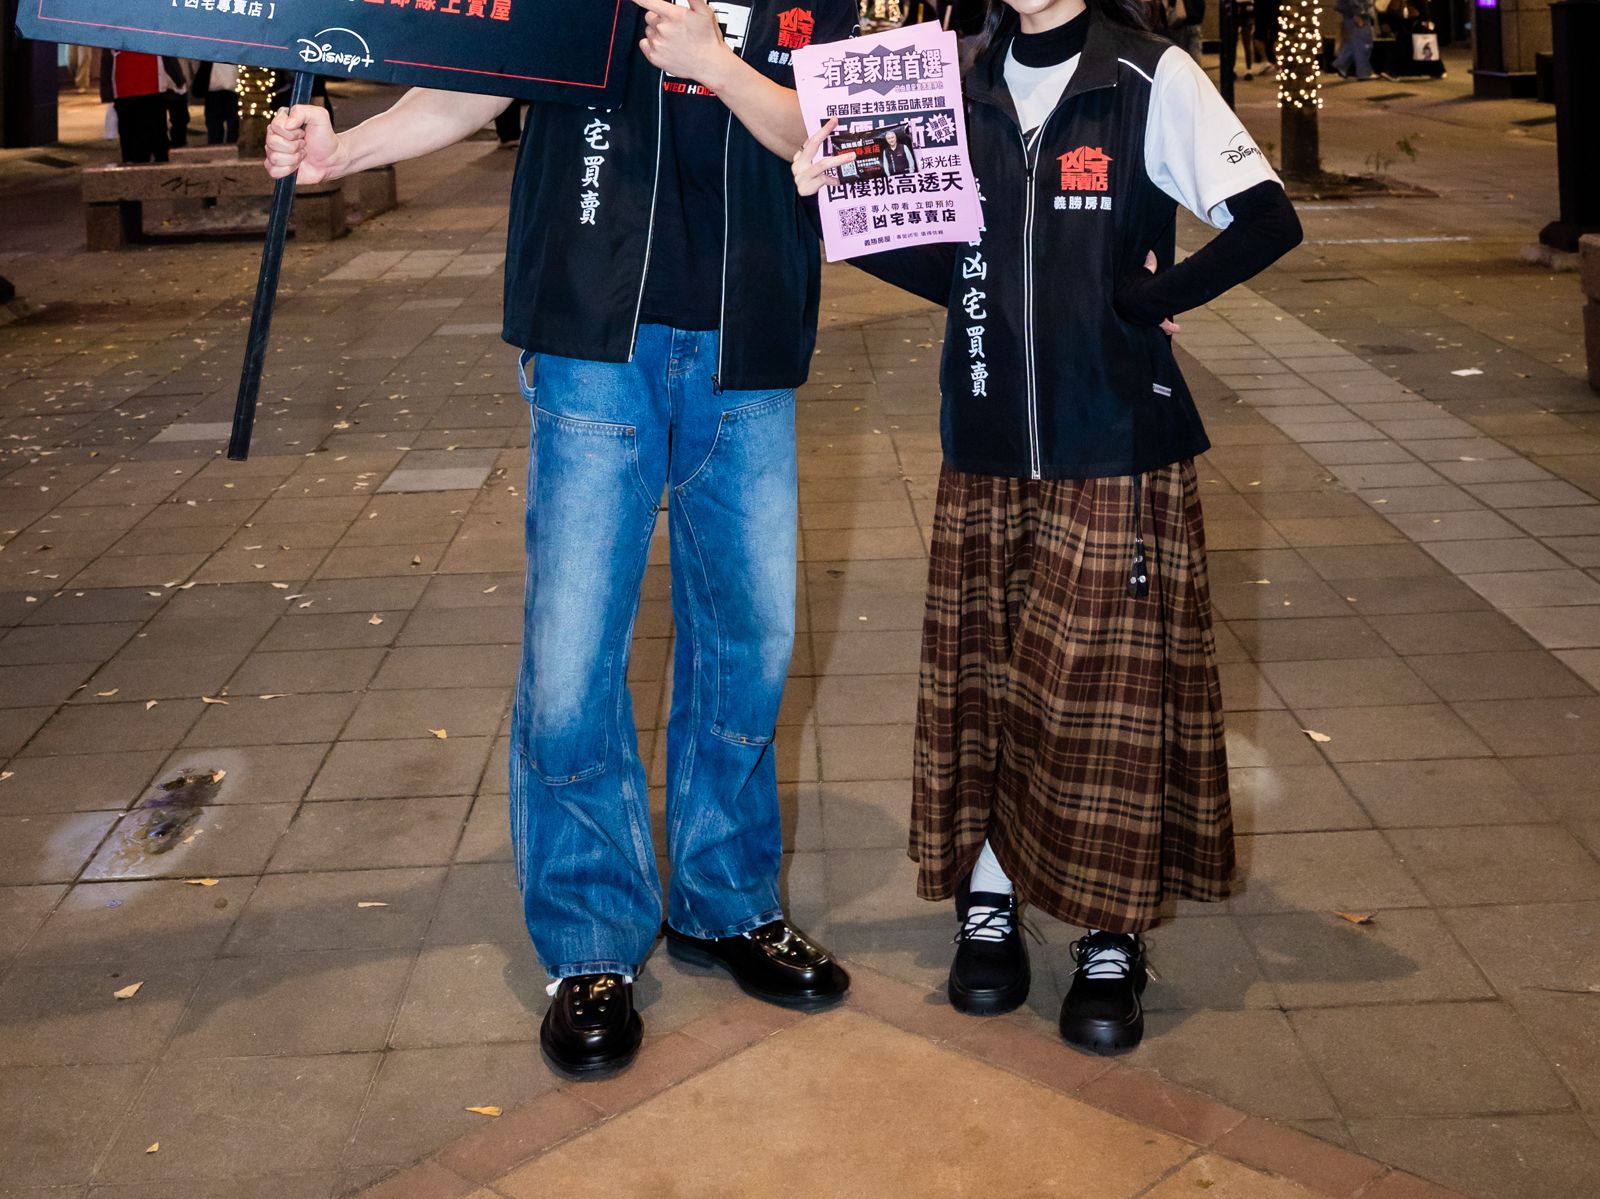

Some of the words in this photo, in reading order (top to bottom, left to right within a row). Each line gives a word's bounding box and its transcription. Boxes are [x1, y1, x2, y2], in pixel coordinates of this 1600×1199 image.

[822, 48, 943, 88] 有愛家庭首選
[826, 96, 946, 117] 保留屋主特殊品味祭壇
[579, 107, 611, 226] 宅買賣
[920, 156, 962, 171] 採光佳
[1055, 145, 1114, 174] 凶宅
[1060, 172, 1109, 192] 專賣店
[871, 202, 910, 213] 專人帶看
[915, 199, 955, 211] 立即預約
[1053, 195, 1112, 211] 義勝房屋
[872, 208, 957, 230] 凶宅專賣店
